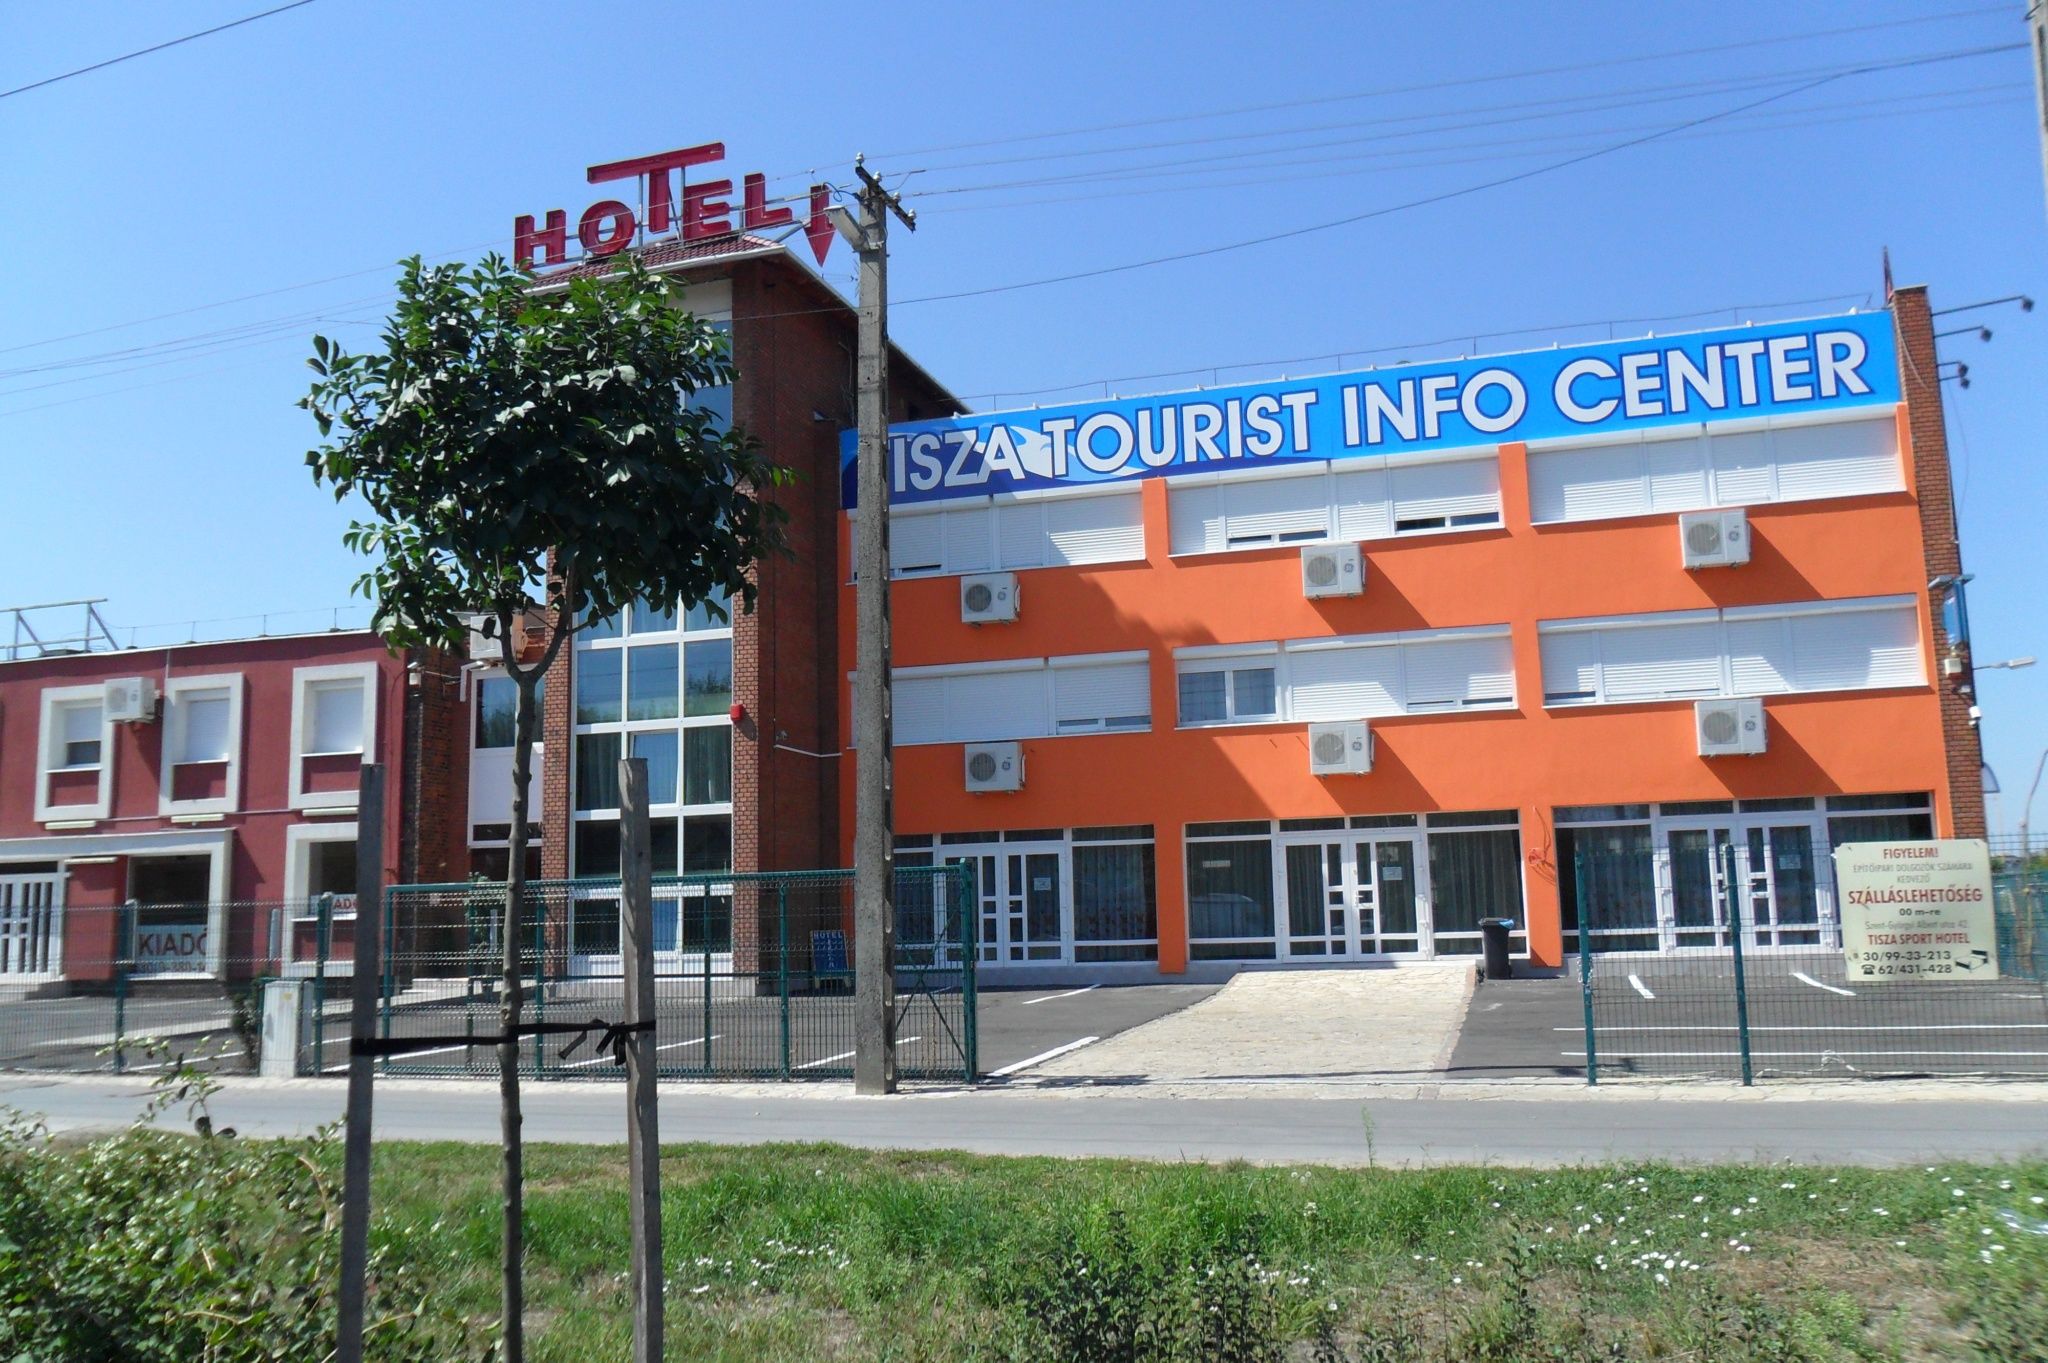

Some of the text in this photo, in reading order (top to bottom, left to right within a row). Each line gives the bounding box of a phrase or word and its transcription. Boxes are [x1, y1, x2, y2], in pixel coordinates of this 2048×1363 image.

[514, 142, 793, 270] HOTEL
[888, 331, 1872, 493] ISZA TOURIST INFO CENTER
[1883, 848, 1939, 859] FIGYELEM!
[1848, 884, 1983, 904] SZÁLLÁSLEHETŐSÉG
[1868, 933, 1970, 945] TISZA SPORT HOTEL
[1863, 951, 1951, 961] 30/99-33-213
[1878, 964, 1952, 974] 62/431-428
